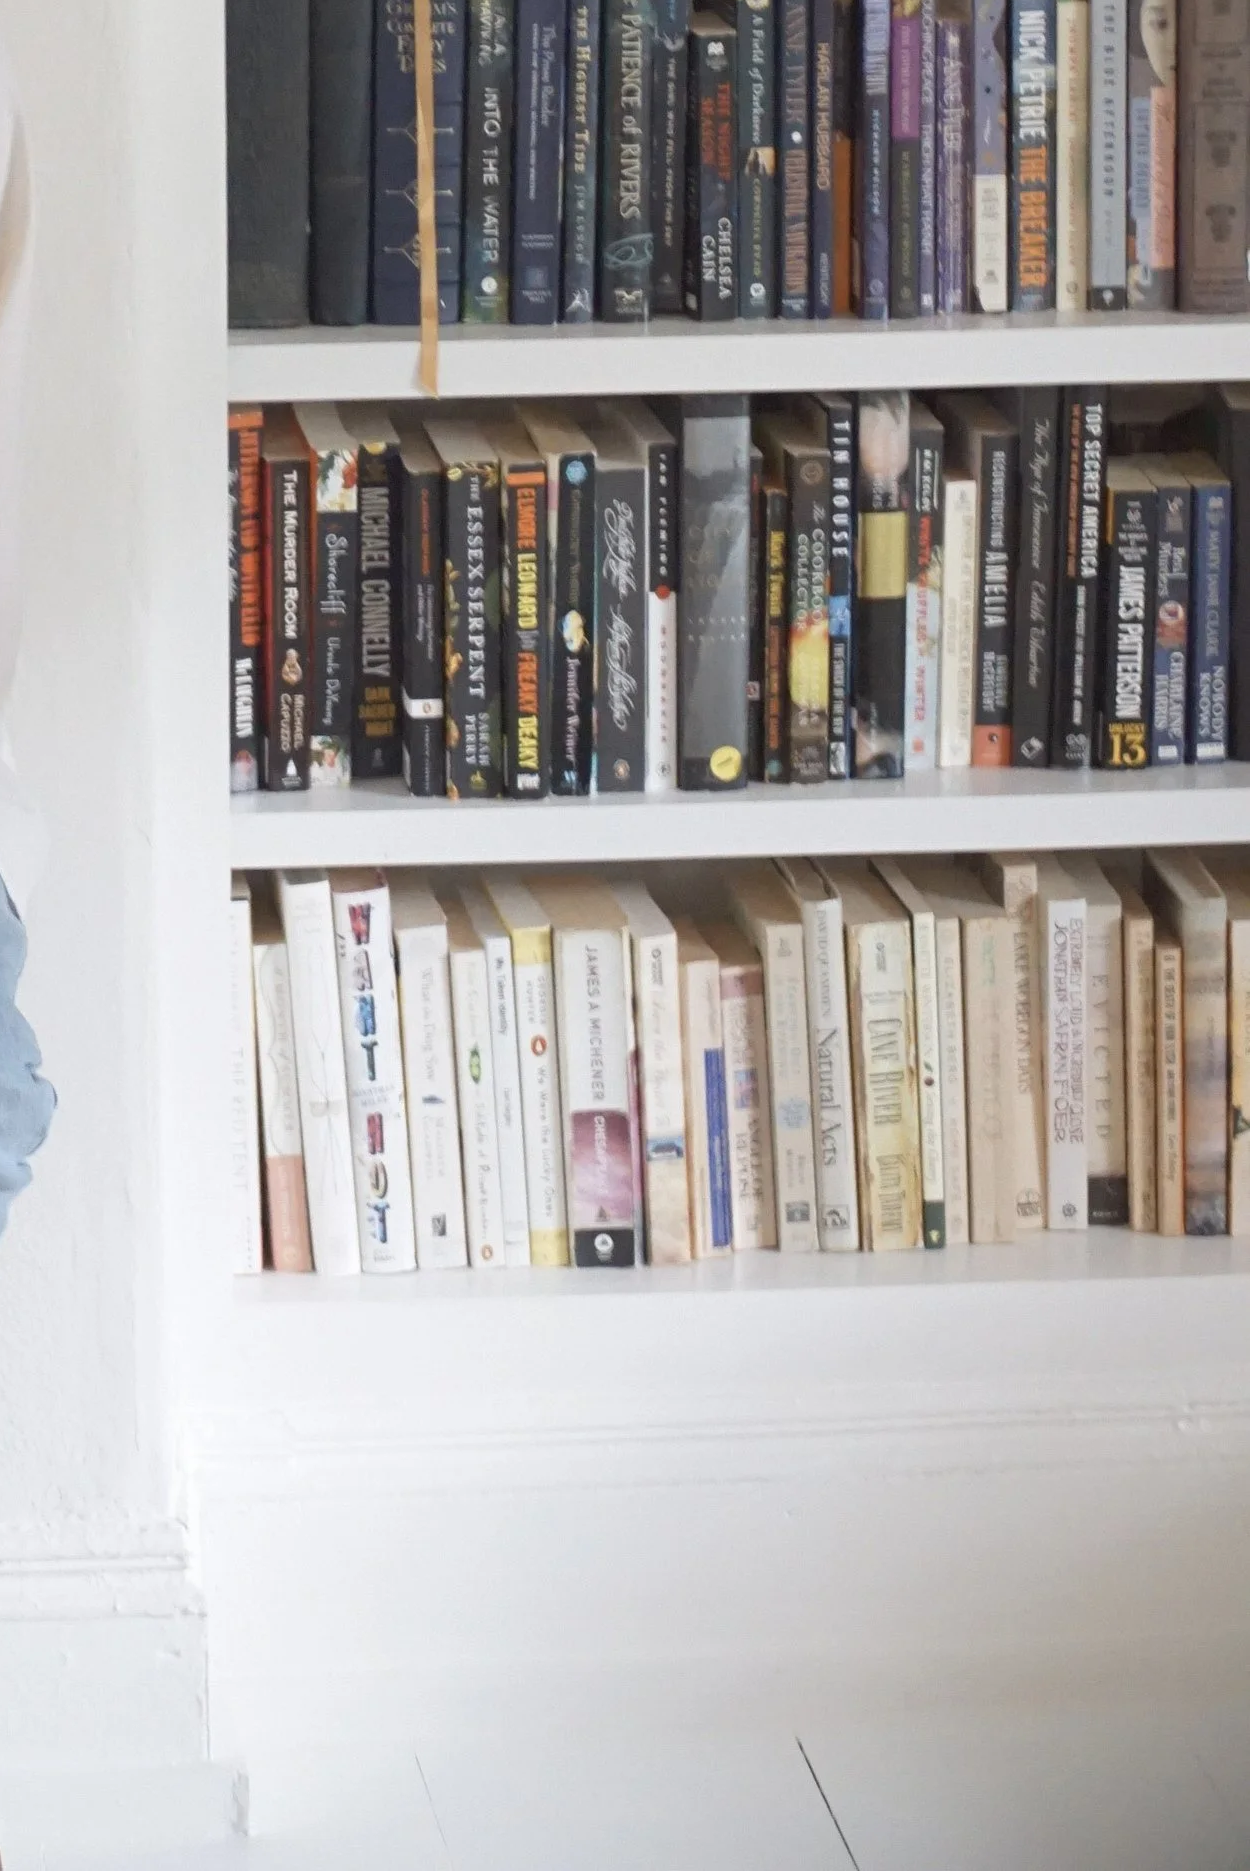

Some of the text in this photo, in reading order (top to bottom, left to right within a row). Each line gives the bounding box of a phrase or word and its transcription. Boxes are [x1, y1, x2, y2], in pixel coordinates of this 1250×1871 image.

[620, 13, 643, 108] PATIENCE
[1103, 3, 1116, 34] THE
[573, 5, 593, 176] THE HIGHEST TIDE
[717, 81, 733, 117] THE
[816, 42, 832, 192] HARLAN HUBBARD
[1018, 9, 1048, 140] NICK PETRIE
[622, 113, 642, 136] of
[481, 86, 502, 264] INTO THE WATER
[619, 142, 643, 220] RIVERS
[1018, 145, 1048, 288] THE BREAKER
[701, 234, 717, 283] CAIN
[717, 216, 734, 301] CHELSEA
[360, 486, 391, 574] MICHAEL
[832, 418, 850, 558] TIN HOUSE
[1080, 402, 1104, 579] TOP SECRET AMERICA
[282, 469, 299, 640] THE MURDER ROOM
[319, 532, 349, 616] Shorecliff
[467, 475, 485, 701] THE ESSEX SERPENT
[796, 532, 810, 632] COLLECTOR
[810, 528, 825, 635] COOKBOOK
[984, 550, 1009, 629] AMELIA
[361, 578, 391, 678] CONNELLY
[516, 487, 539, 770] ELMORE LEONARD FREAKY DEAKY
[1114, 564, 1146, 720] JAMES PATTERSON
[279, 692, 292, 753] CAPUZZO
[293, 693, 305, 750] MICHAEL
[464, 713, 477, 765] PERRY
[478, 711, 491, 767] SARAH
[1154, 674, 1169, 732] HARRIS
[1168, 651, 1186, 741] CHARLAINE
[1199, 673, 1214, 737] KNOWS
[1212, 664, 1228, 741] NOBODY
[1108, 732, 1146, 767] 13
[1013, 931, 1032, 974] LAKE
[583, 943, 607, 1102] JAMES A MICHENER
[1053, 920, 1070, 1145] JONATHAN SAFRAN FOER
[1091, 974, 1112, 1139] EVICTED
[816, 1027, 844, 1167] Natural Acts
[866, 1017, 905, 1128] CANE RIVER
